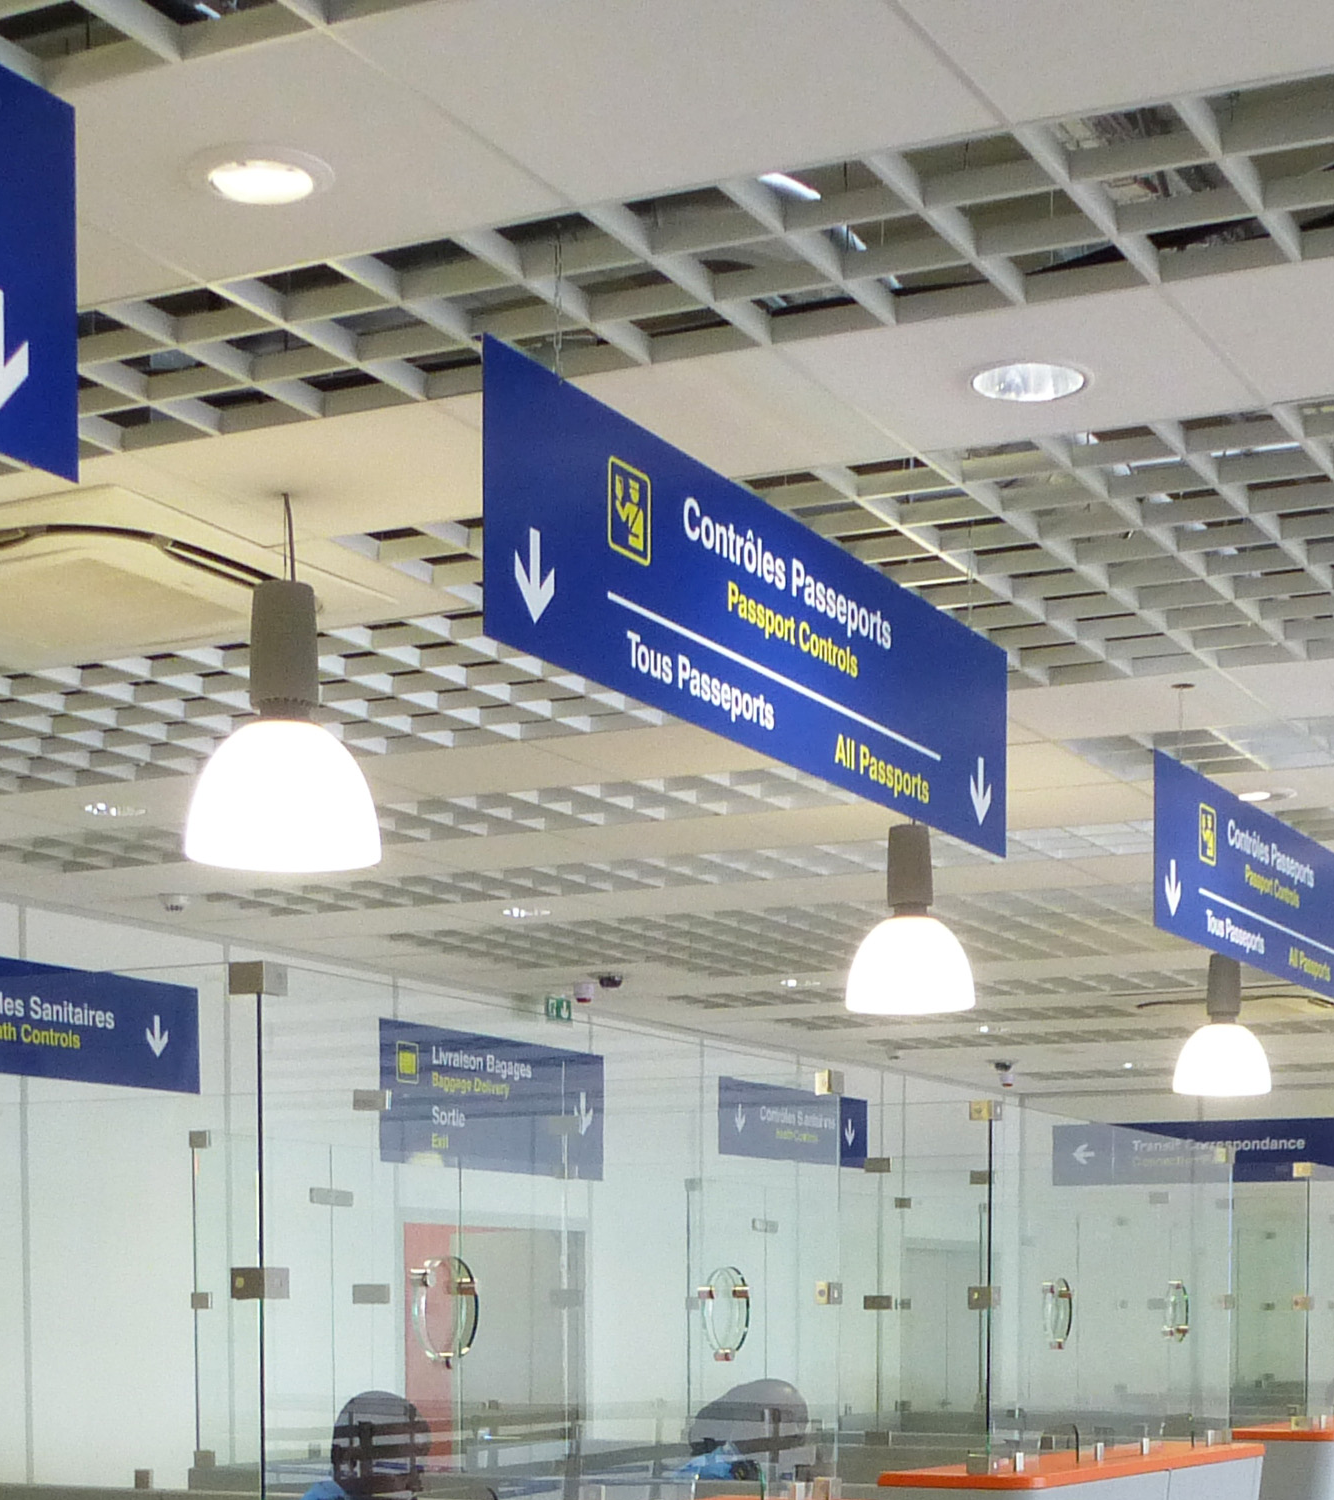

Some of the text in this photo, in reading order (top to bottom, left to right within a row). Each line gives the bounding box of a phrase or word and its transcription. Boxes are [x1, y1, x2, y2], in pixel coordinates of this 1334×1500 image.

[683, 496, 892, 650] Contrôles Passeports
[727, 580, 859, 679] Passport Controls
[627, 630, 775, 731] Tous Passeports
[835, 733, 930, 804] All Passports
[1271, 843, 1315, 889] Passeports
[1205, 908, 1225, 938] Tous
[29, 995, 115, 1030] Sanitaires
[20, 1024, 82, 1050] Controls
[431, 1045, 533, 1081] Livraison Bagages
[431, 1104, 467, 1128] Sortie
